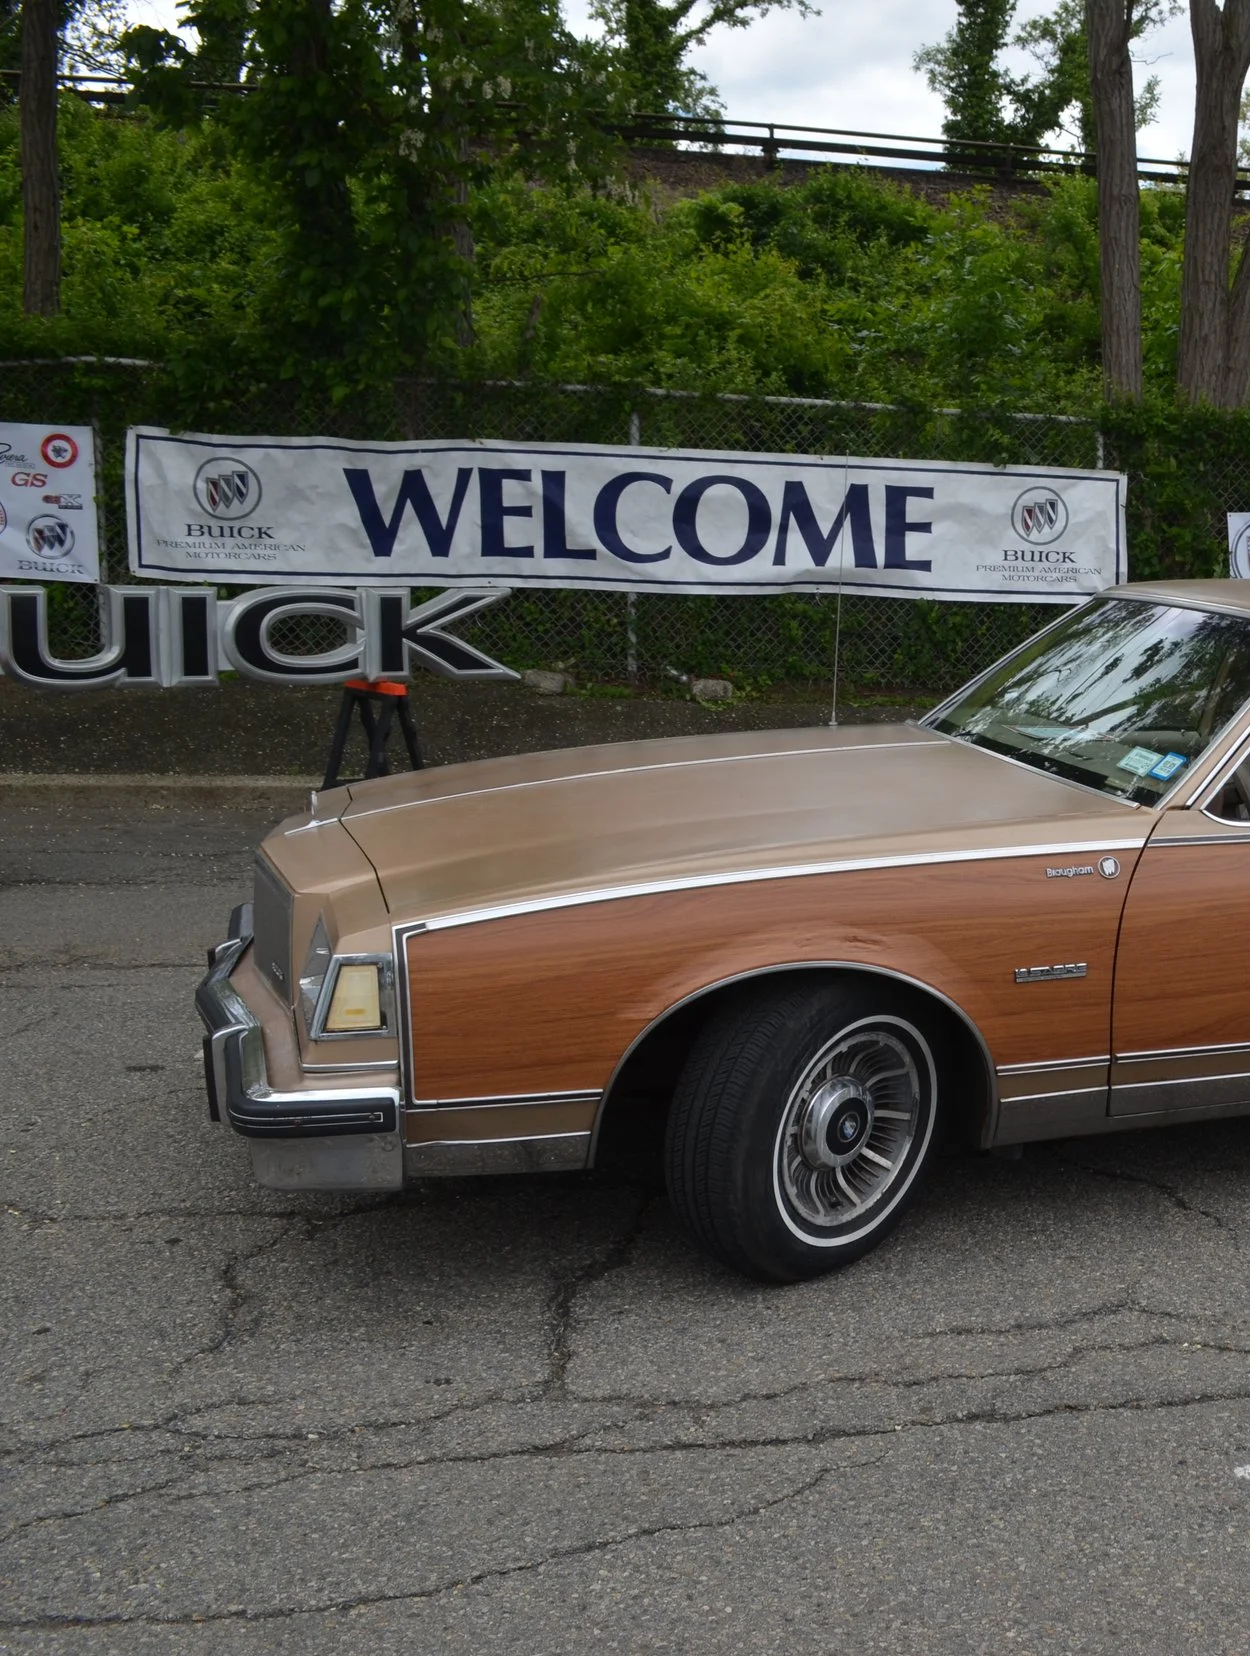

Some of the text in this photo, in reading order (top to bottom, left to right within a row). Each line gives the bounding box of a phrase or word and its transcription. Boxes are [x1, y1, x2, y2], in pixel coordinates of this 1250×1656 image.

[11, 471, 48, 488] GS
[342, 467, 934, 572] WELCOME
[184, 523, 276, 539] BUICK
[156, 539, 306, 552] PREMIUM AMERICAN
[185, 551, 277, 561] MOTORCARS
[1002, 549, 1077, 564] BUICK
[17, 559, 85, 575] BUICK
[976, 564, 1103, 575] PREMIUM AMERICAN
[1001, 574, 1078, 583] MOTORCARS
[1046, 865, 1094, 878] Brougham
